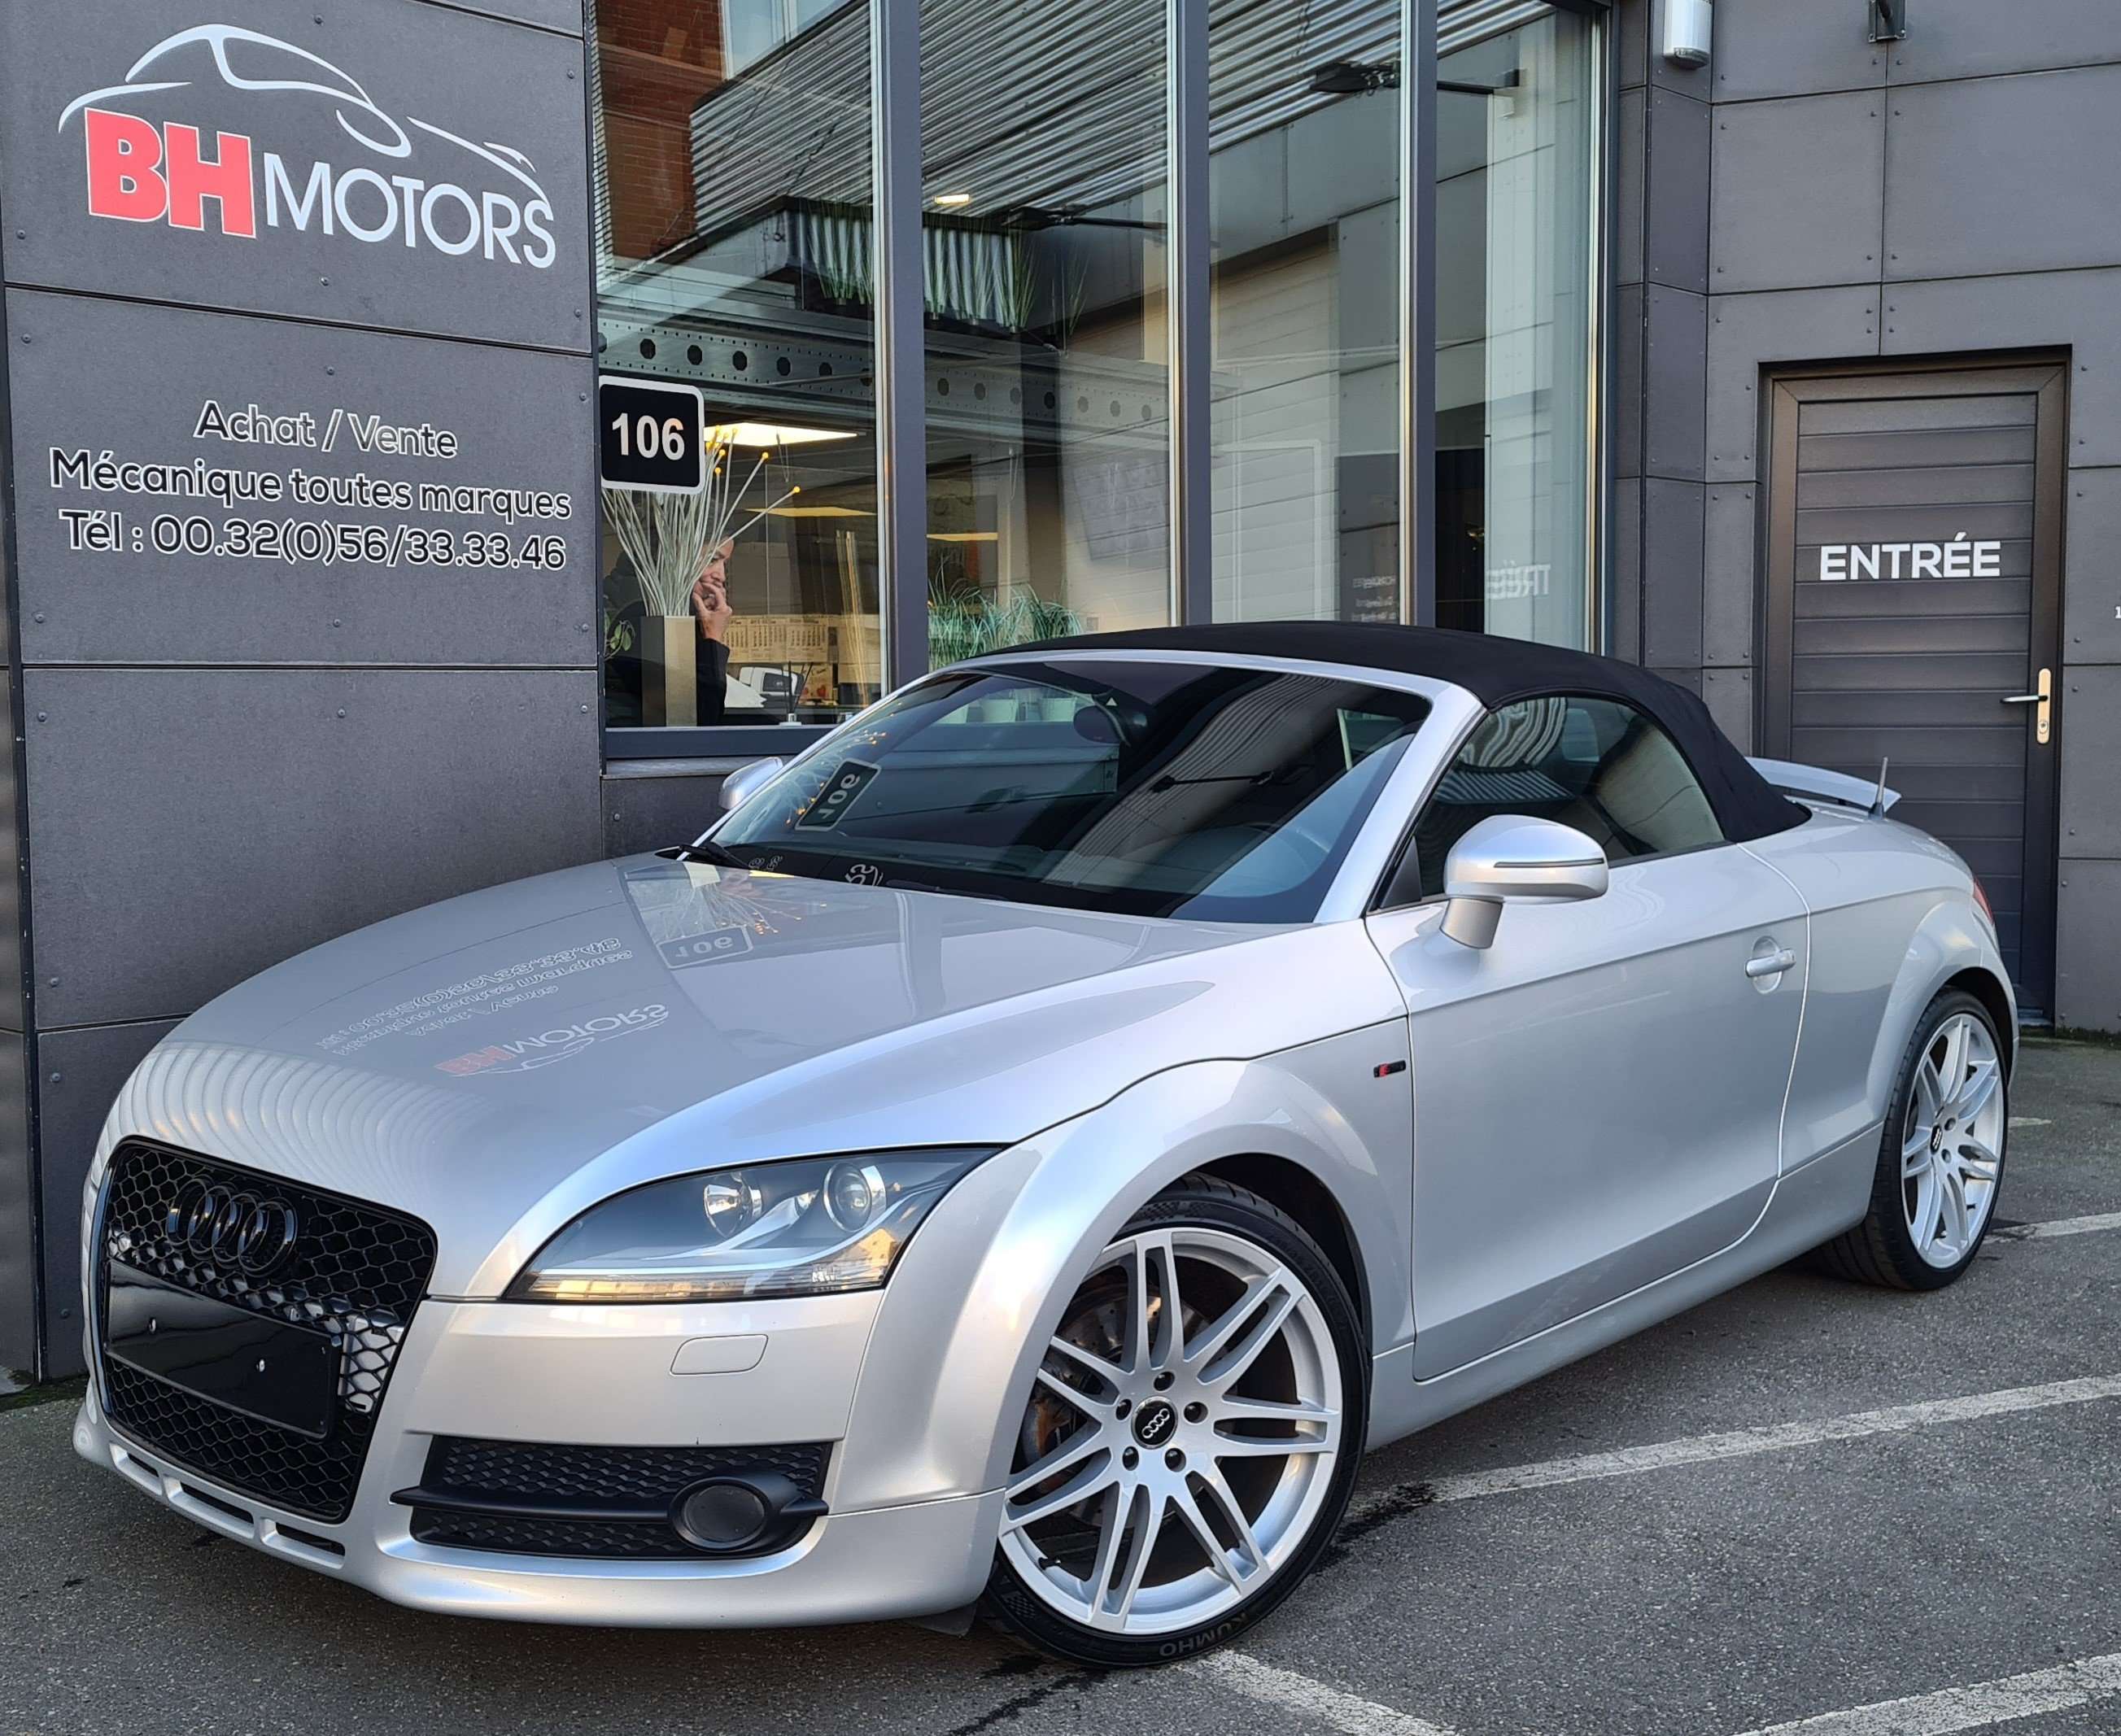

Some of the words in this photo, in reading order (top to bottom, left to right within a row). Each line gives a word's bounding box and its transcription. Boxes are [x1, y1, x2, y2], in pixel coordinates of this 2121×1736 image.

[85, 107, 256, 238] BH
[264, 153, 556, 268] MOTORS
[193, 400, 316, 447] Achat
[348, 413, 458, 459] Vente
[612, 412, 685, 460] 106
[49, 447, 281, 509] Mécanique
[289, 471, 412, 510] toutes
[420, 485, 572, 525] marques
[151, 515, 566, 570] 00.32(0)56/33.33.46
[1820, 531, 2001, 581] ENTRÉE
